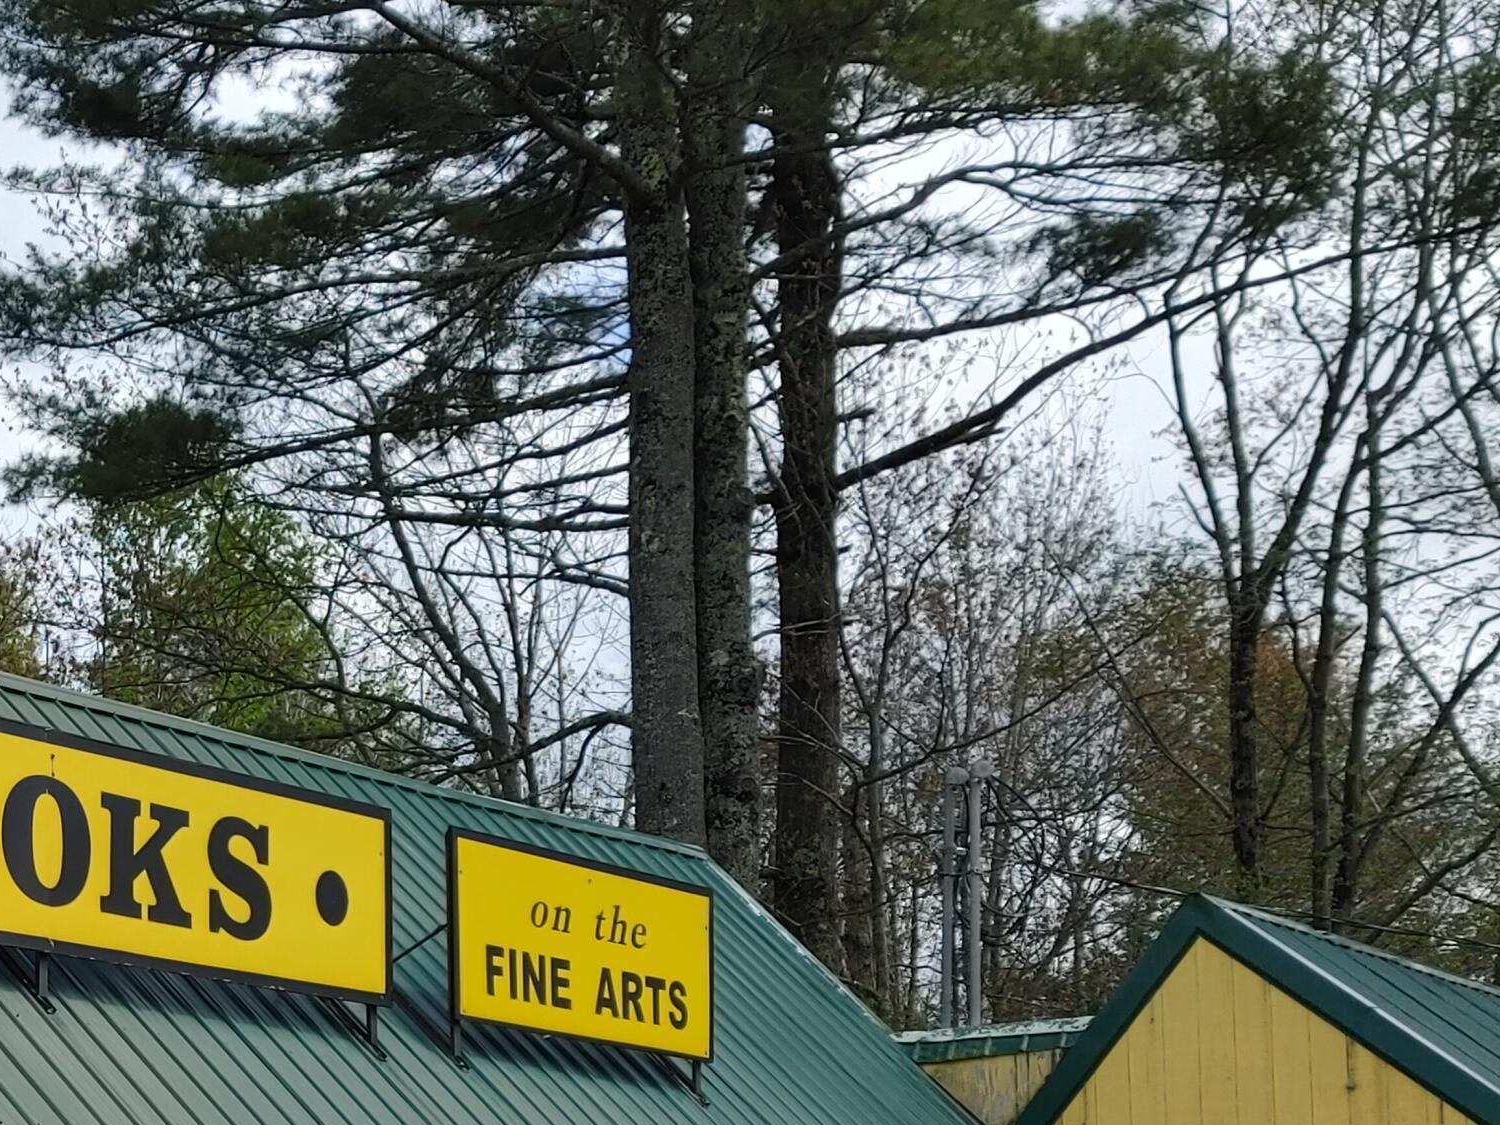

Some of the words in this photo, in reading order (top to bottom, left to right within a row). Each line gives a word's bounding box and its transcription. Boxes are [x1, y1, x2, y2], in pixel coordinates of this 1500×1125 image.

[530, 901, 571, 933] on
[595, 905, 647, 949] the
[485, 944, 572, 1010] FINE
[595, 967, 688, 1030] ARTS
